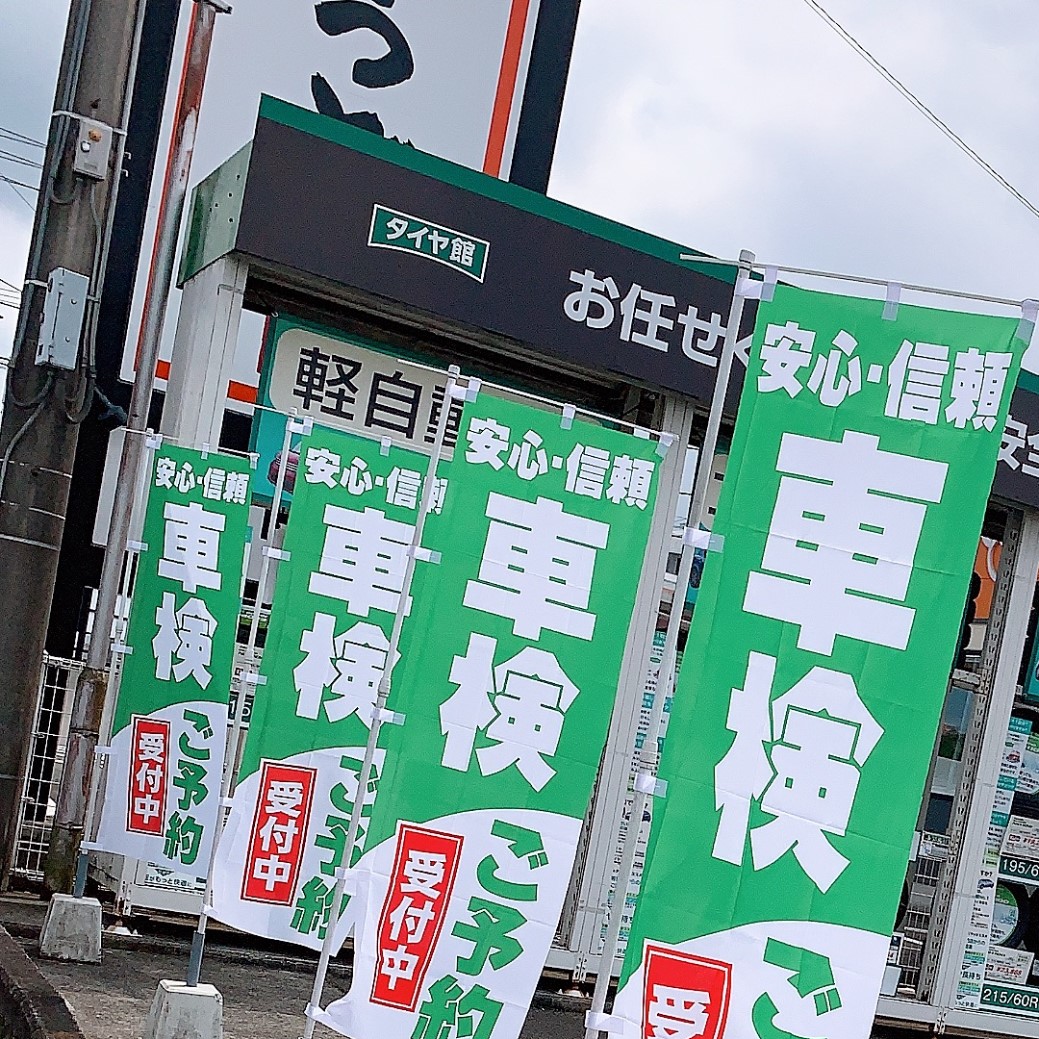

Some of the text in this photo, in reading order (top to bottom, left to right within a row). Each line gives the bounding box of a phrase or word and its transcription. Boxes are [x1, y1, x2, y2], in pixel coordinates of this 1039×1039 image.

[385, 216, 477, 268] タイヤ館
[152, 502, 226, 690] 車検
[293, 503, 416, 729] 車検
[439, 491, 610, 793] 車検
[711, 429, 949, 894] 車検
[133, 733, 166, 826] 受付中
[163, 708, 213, 865] ご予約
[253, 780, 305, 892] 受付中
[378, 850, 446, 991] 受付中
